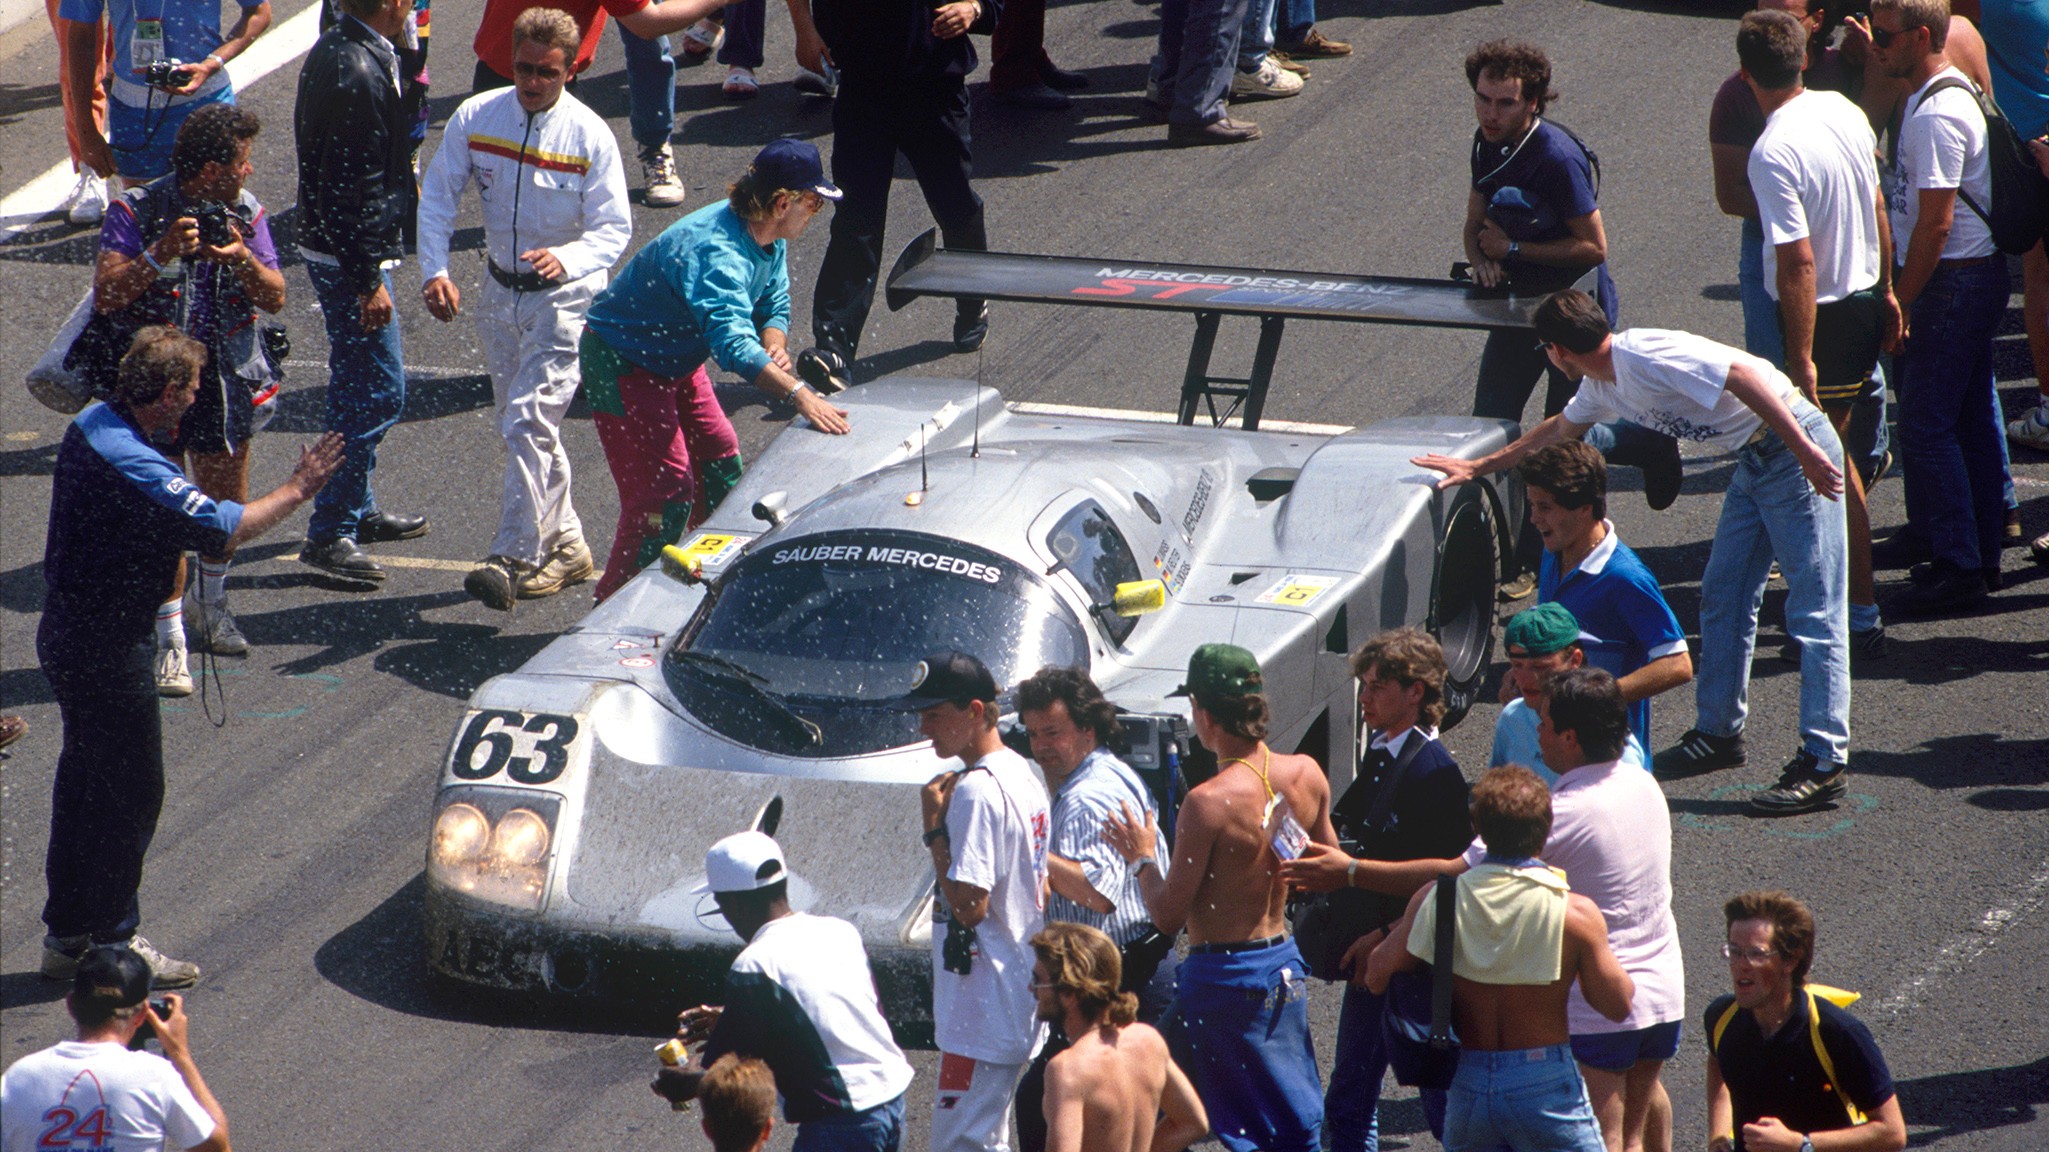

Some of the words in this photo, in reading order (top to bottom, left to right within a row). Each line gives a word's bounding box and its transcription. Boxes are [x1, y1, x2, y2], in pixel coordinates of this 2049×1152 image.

[1071, 278, 1233, 299] ST
[1095, 267, 1413, 296] MERCEDES-BENZ
[772, 545, 862, 564] SAUBER
[866, 546, 1001, 584] MERCEDES
[452, 709, 579, 785] 63
[37, 1105, 113, 1148] 24
